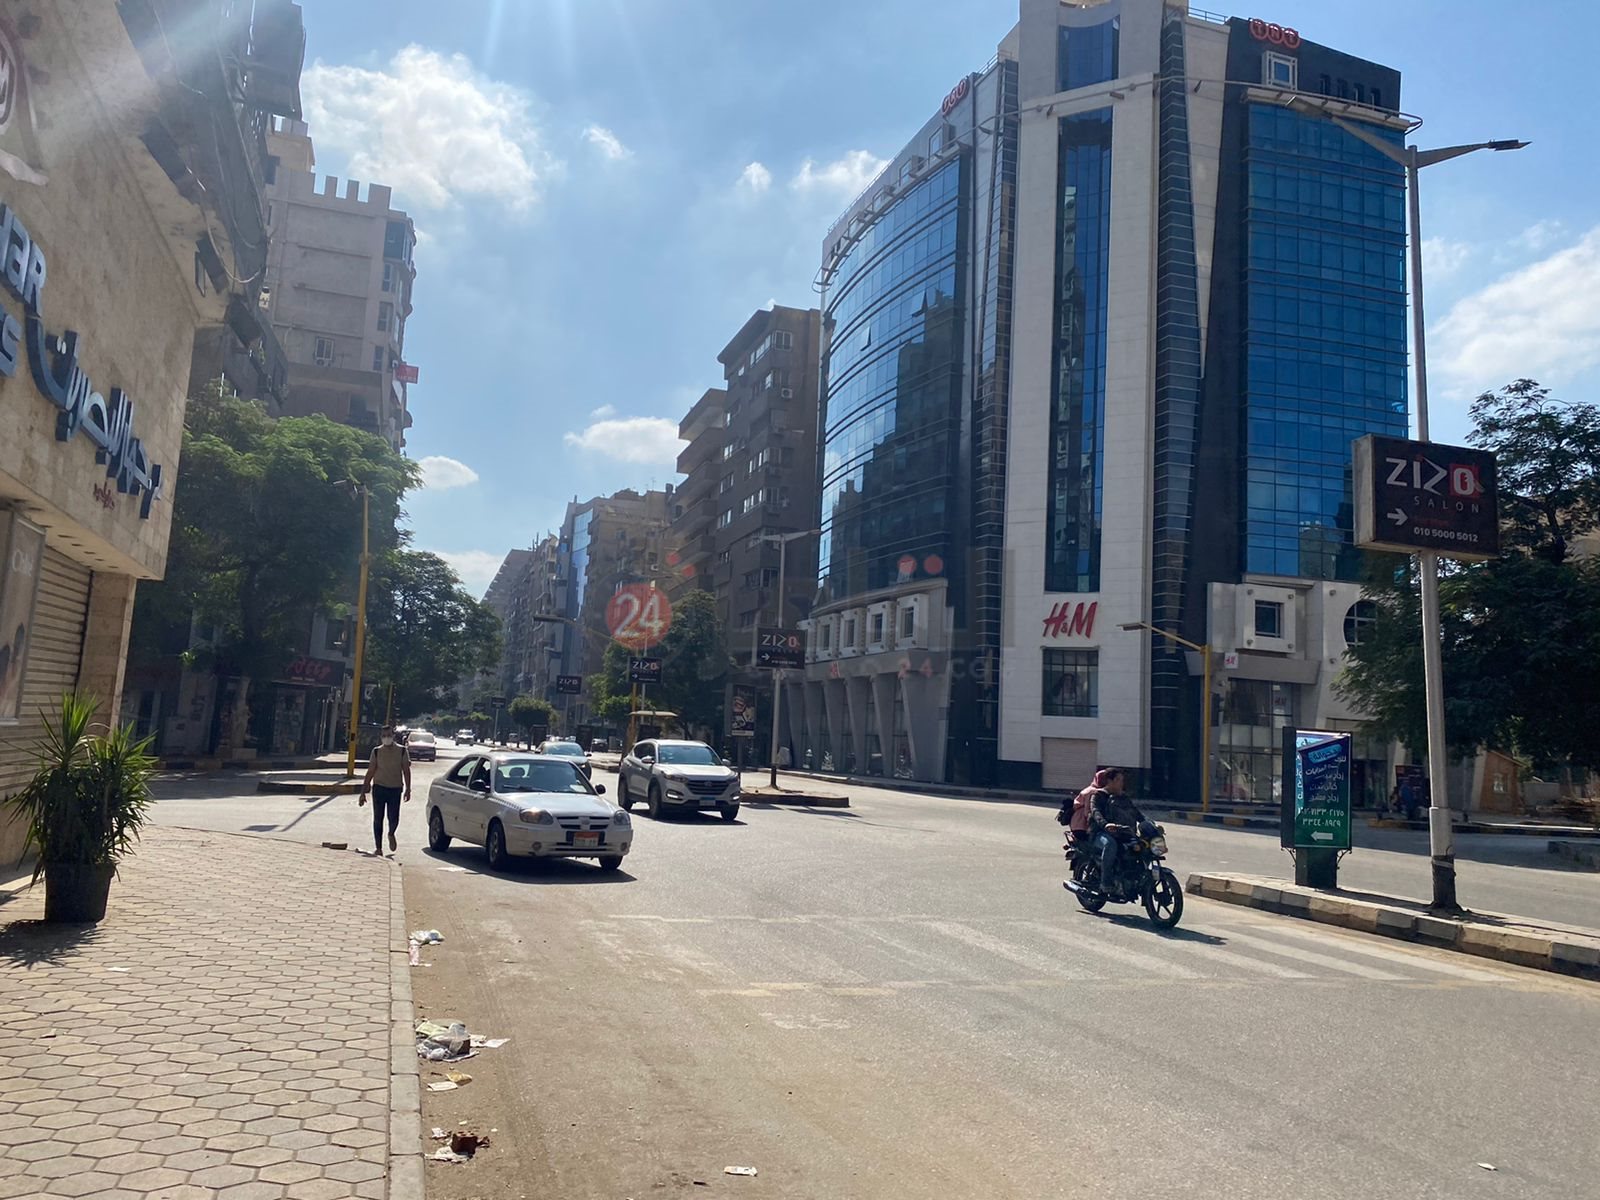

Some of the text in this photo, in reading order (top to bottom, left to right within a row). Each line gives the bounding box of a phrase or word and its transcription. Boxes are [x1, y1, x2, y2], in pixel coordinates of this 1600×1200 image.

[1413, 496, 1480, 513] SALON
[1413, 526, 1479, 543] 010 5000 5012
[1042, 601, 1098, 639] H&M
